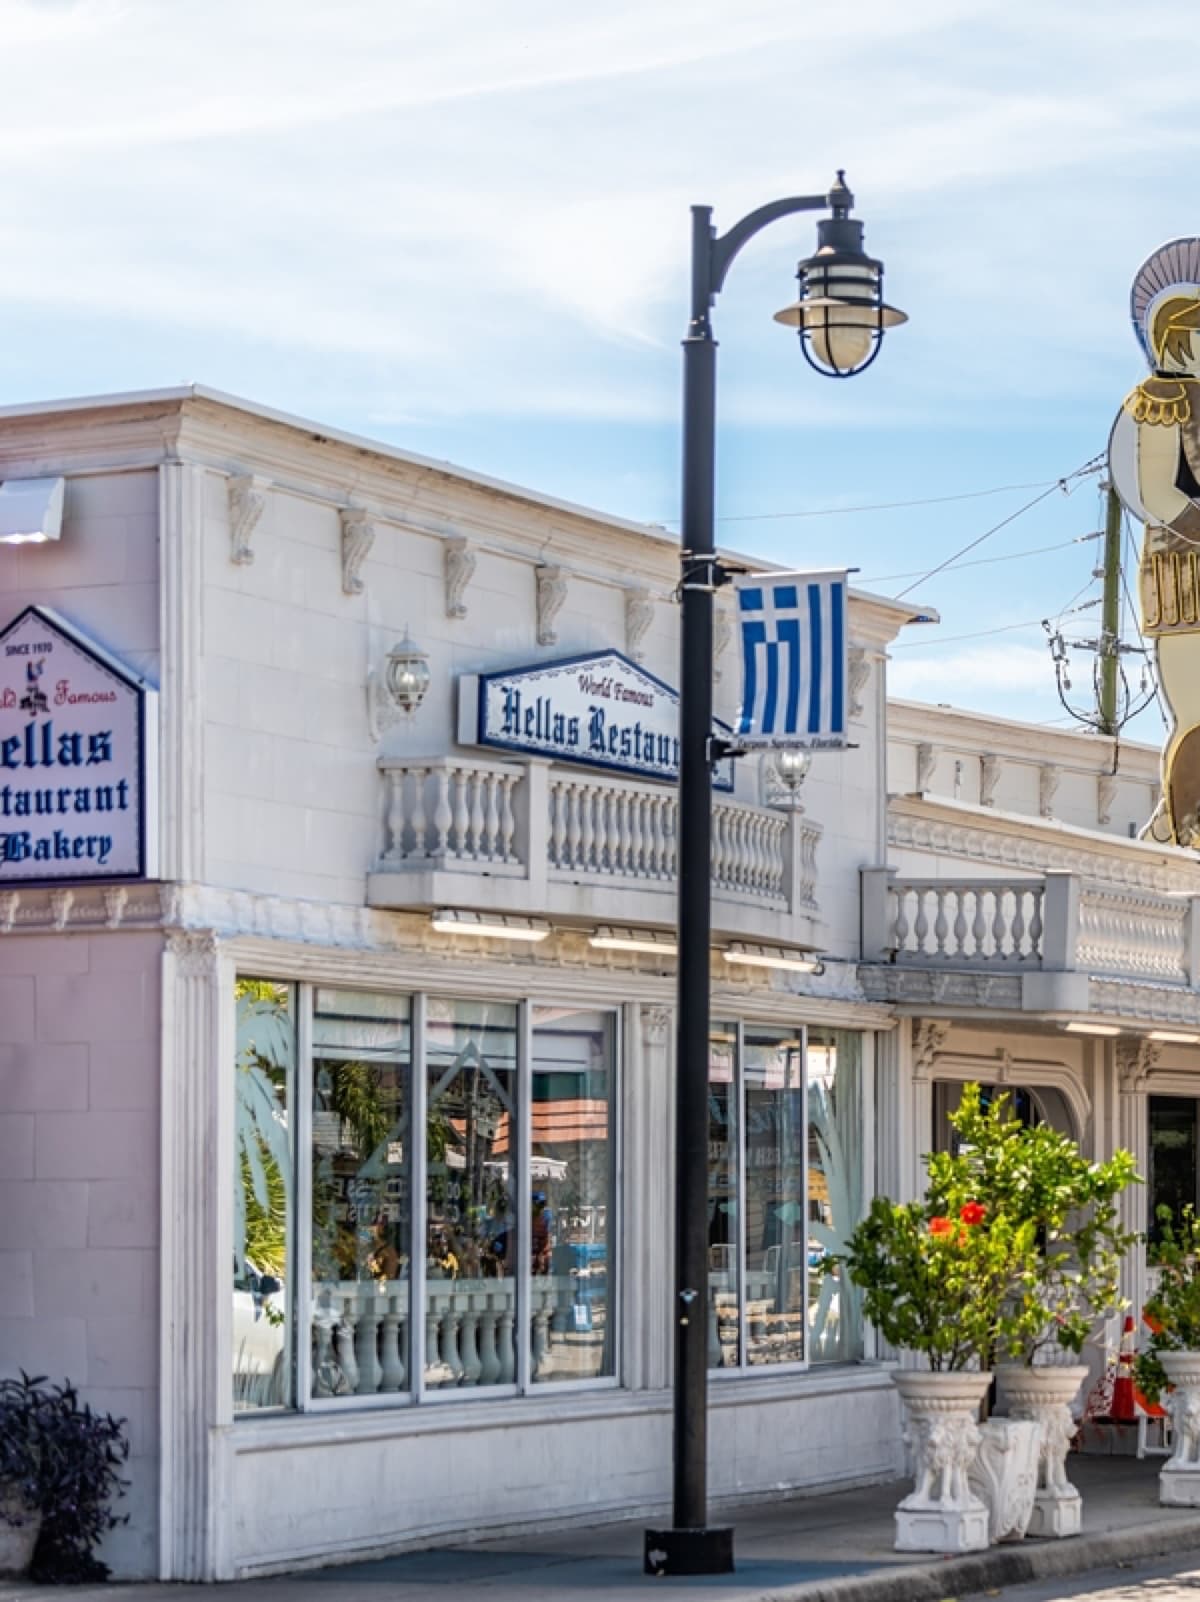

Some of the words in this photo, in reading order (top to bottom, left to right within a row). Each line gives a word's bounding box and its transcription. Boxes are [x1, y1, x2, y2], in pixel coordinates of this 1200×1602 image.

[5, 644, 30, 656] SINCE
[54, 679, 117, 706] Famous
[578, 674, 613, 698] World
[614, 683, 655, 708] Famous
[0, 719, 113, 769] ellas
[500, 685, 580, 745] Hellas
[588, 704, 680, 768] Restaur
[0, 778, 129, 817] taurant
[0, 829, 113, 868] Bakery
